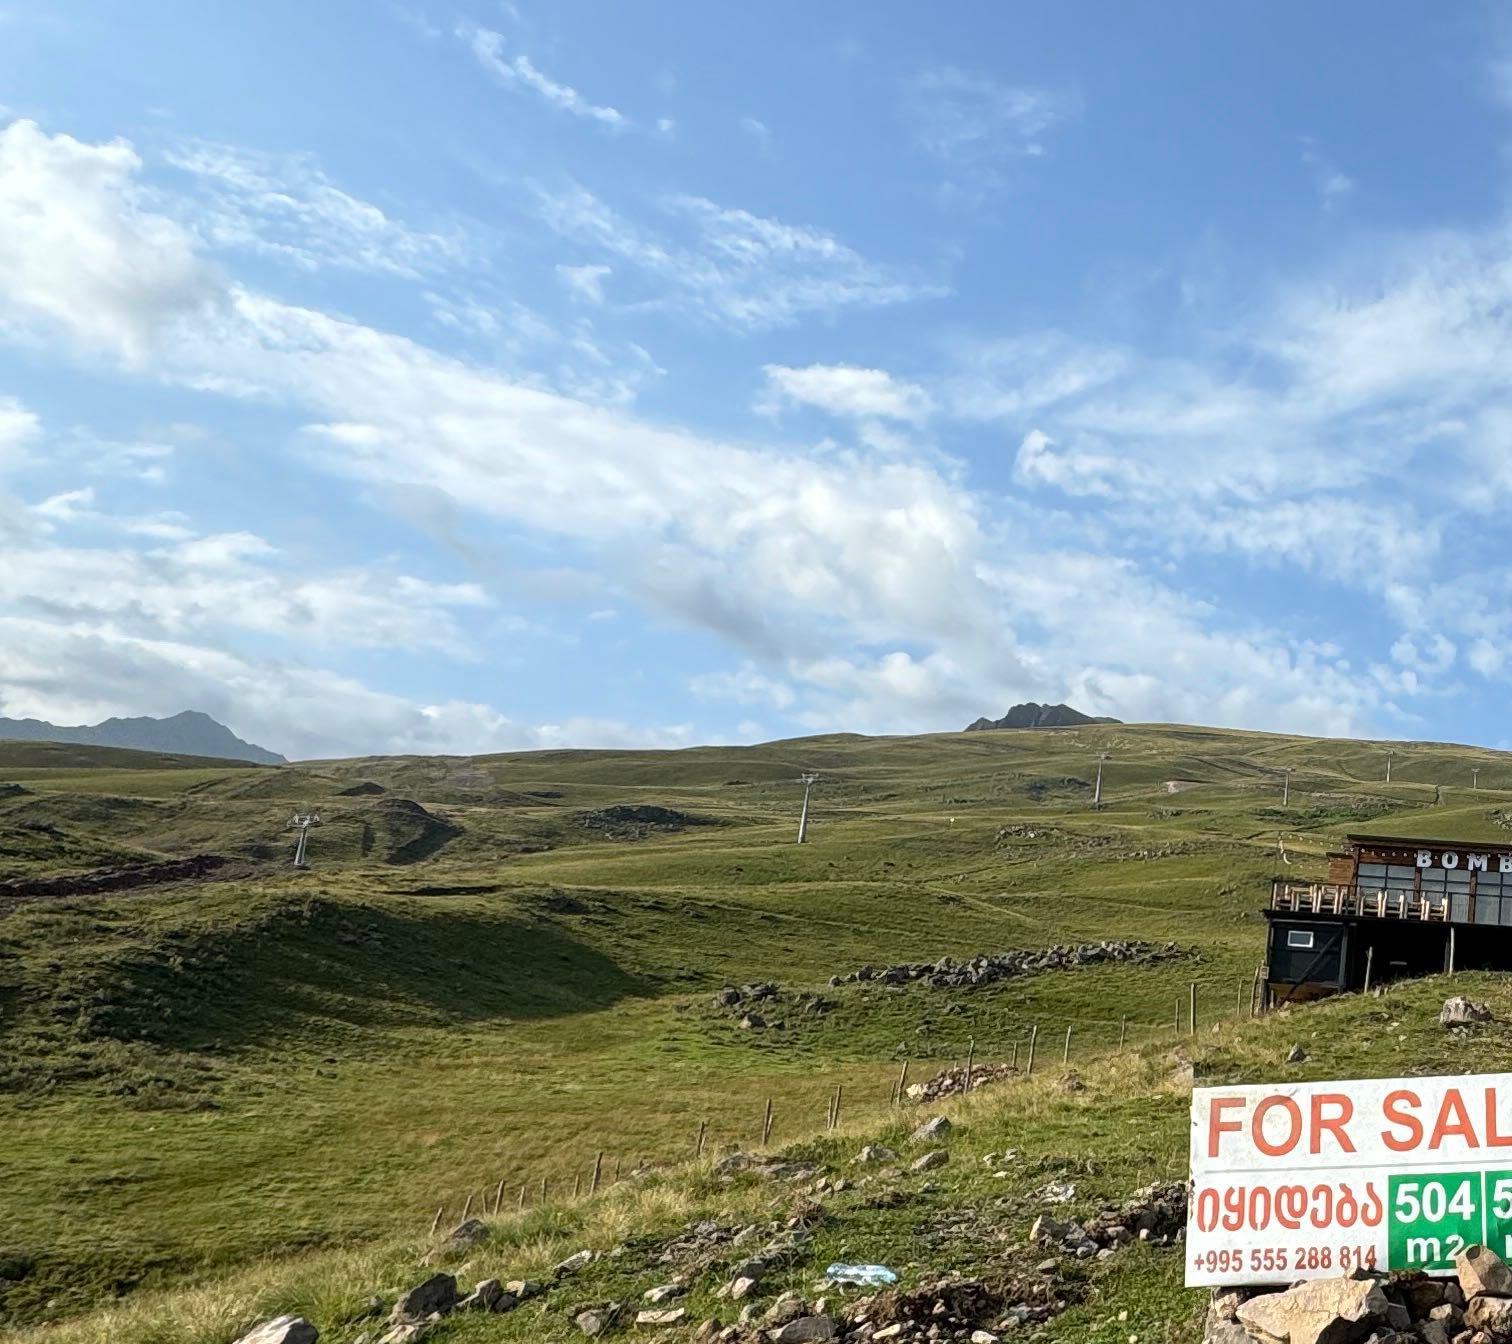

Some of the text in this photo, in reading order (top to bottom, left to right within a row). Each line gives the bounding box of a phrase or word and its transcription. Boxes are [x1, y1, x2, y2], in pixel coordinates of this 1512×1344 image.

[1207, 1093, 1356, 1158] FOR
[1196, 1182, 1384, 1233] იყიდება
[1395, 1180, 1476, 1224] 504
[1193, 1244, 1377, 1274] +995 555 288 814
[1406, 1233, 1466, 1263] m2
